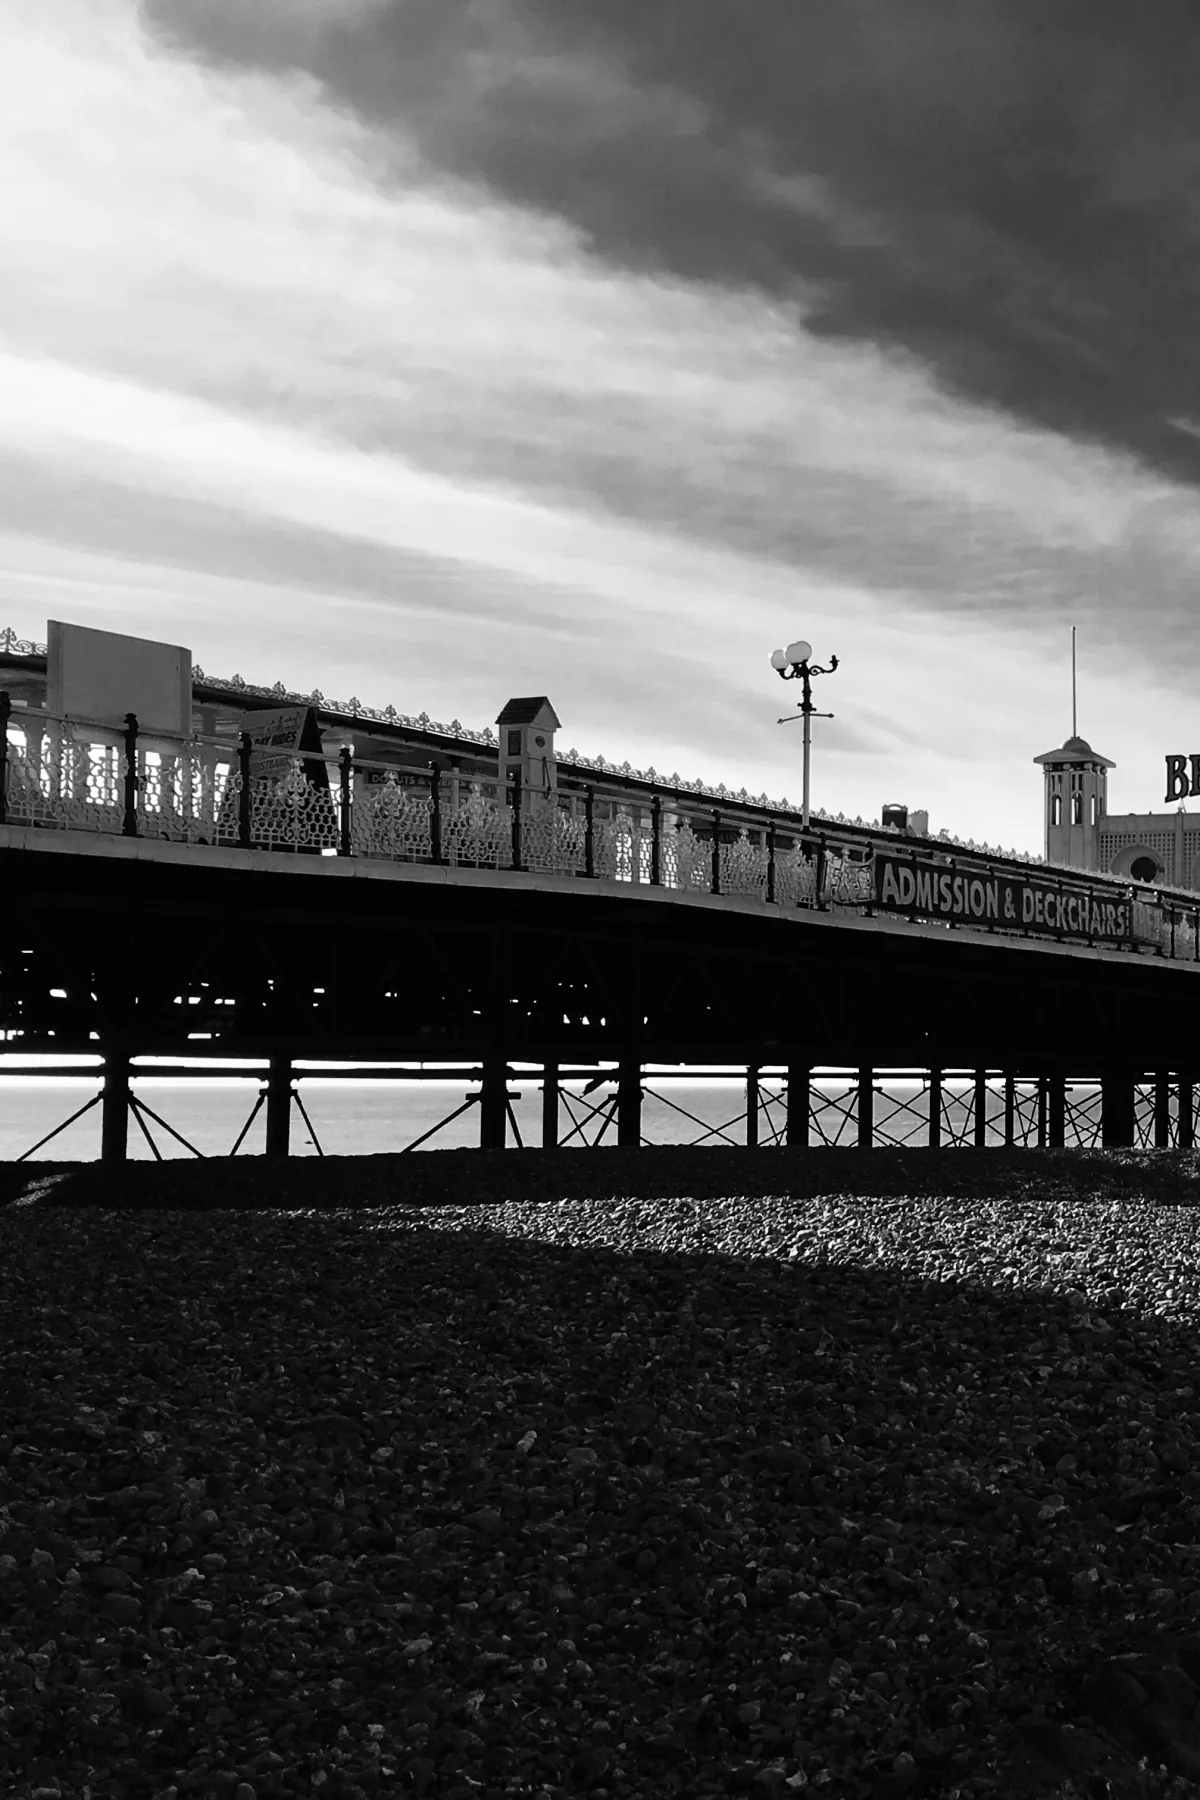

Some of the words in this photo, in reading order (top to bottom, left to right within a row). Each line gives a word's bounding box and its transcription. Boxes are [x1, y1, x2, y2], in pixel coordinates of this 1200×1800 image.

[267, 730, 297, 746] RIDES
[372, 774, 415, 784] DOUTS
[882, 863, 998, 920] ADMISSION
[1003, 887, 1016, 920] &
[1021, 887, 1130, 937] DECKCHAIRS!
